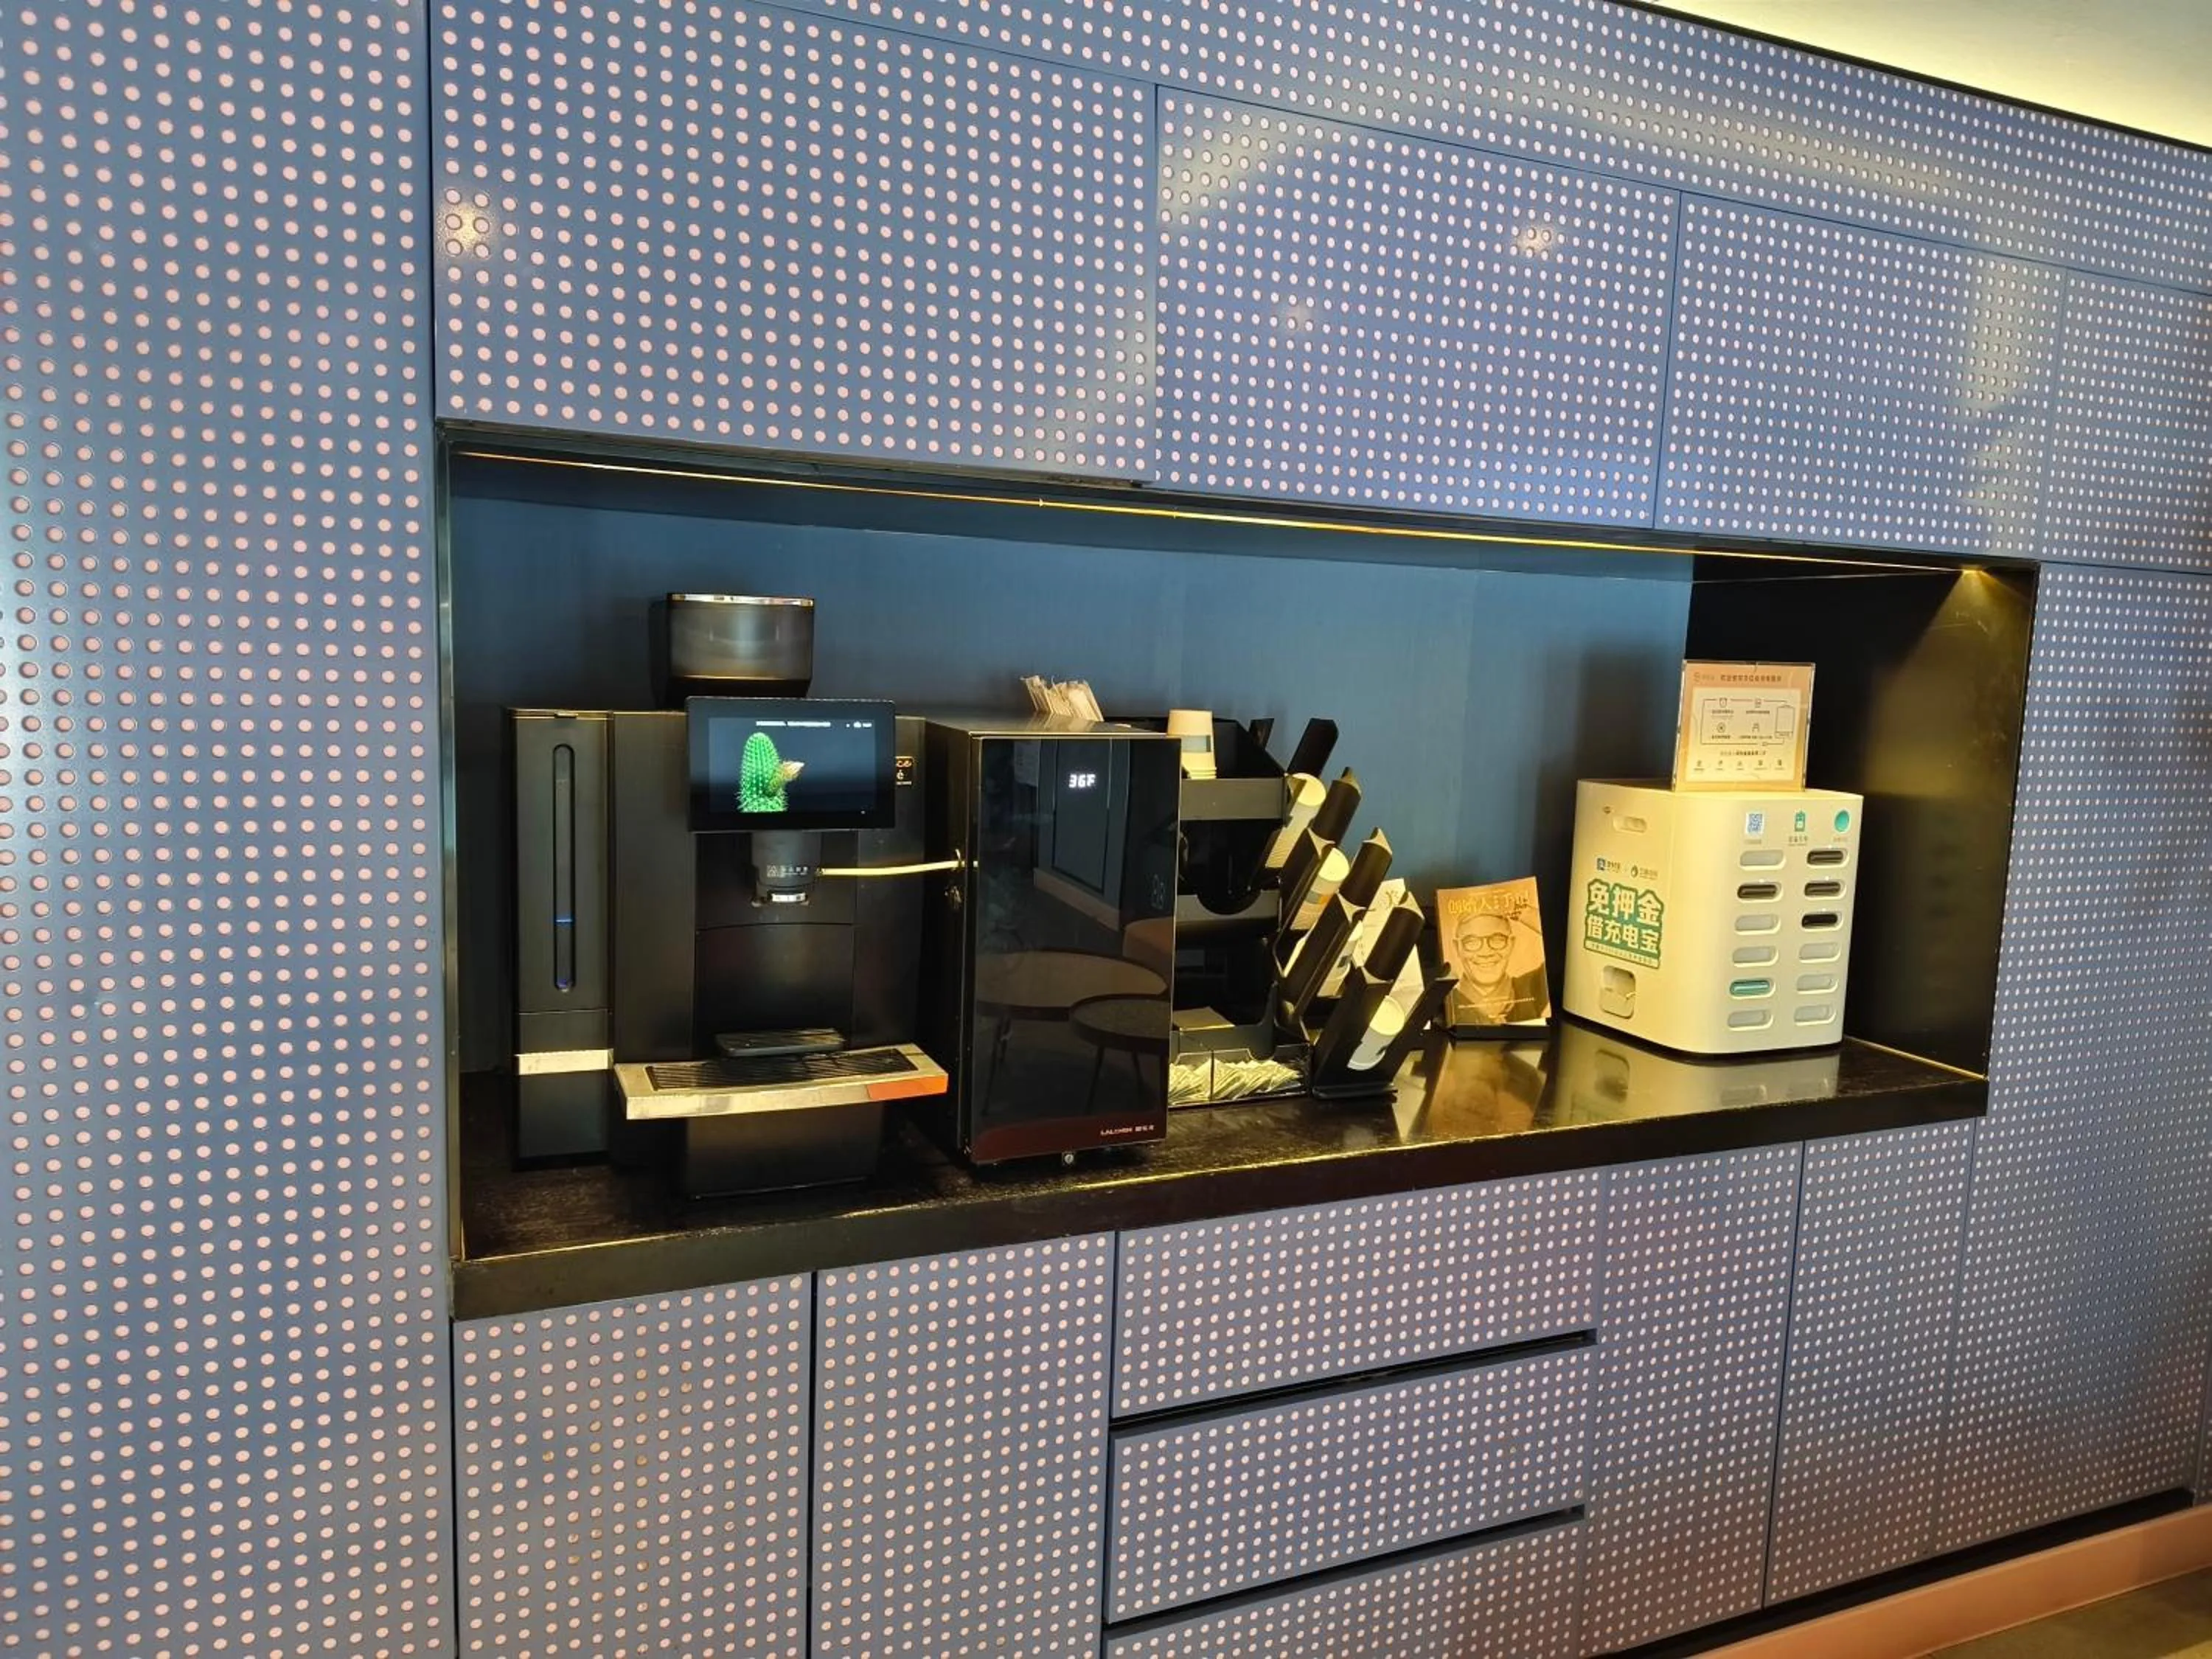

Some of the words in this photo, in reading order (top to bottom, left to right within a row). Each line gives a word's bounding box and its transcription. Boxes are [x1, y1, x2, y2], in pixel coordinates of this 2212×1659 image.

[1588, 882, 1660, 927] 免押金
[1587, 914, 1660, 954] 借充电宝
